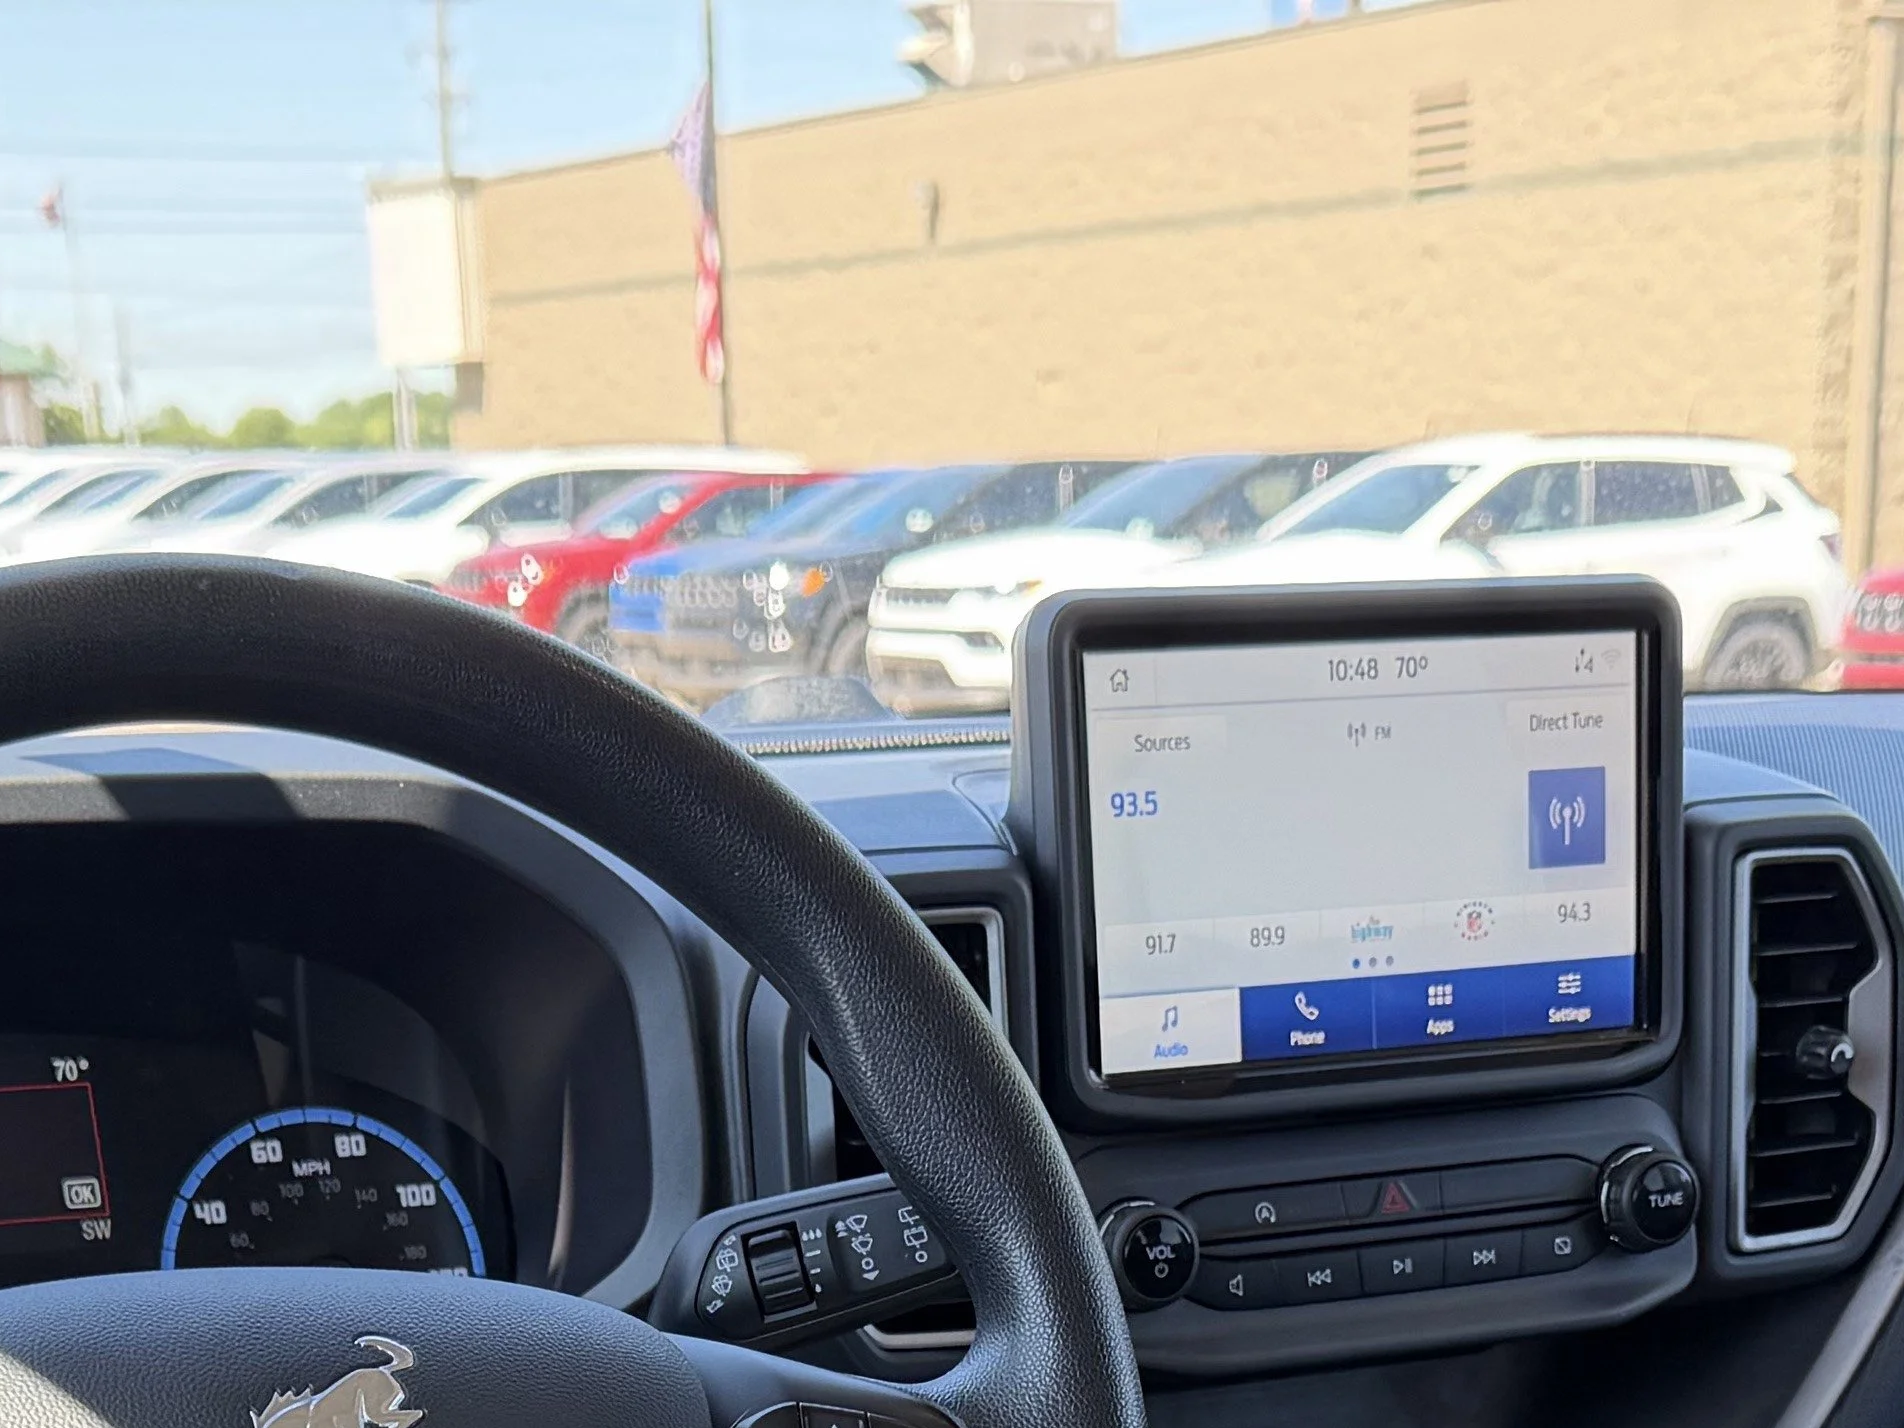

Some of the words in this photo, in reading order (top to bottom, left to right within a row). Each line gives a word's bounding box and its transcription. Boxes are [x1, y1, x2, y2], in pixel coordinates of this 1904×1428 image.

[1328, 657, 1379, 682] 10:48
[1529, 712, 1569, 732] Direct
[1571, 711, 1604, 729] Tune
[1134, 734, 1191, 752] Sources
[1110, 790, 1159, 818] 93.5
[1557, 901, 1592, 924] 94.3
[1146, 933, 1176, 955] 91.7
[1250, 926, 1286, 948] 89.9
[1290, 1030, 1326, 1046] Phone
[1154, 1043, 1189, 1059] Audio
[249, 1138, 283, 1163] 60
[334, 1132, 367, 1158] 80
[291, 1158, 331, 1178] MPH
[71, 1185, 97, 1204] OK
[395, 1183, 437, 1208] 100
[1648, 1191, 1684, 1208] TUNE
[192, 1200, 228, 1225] 40
[81, 1218, 111, 1240] SW
[1146, 1244, 1176, 1260] VOL
